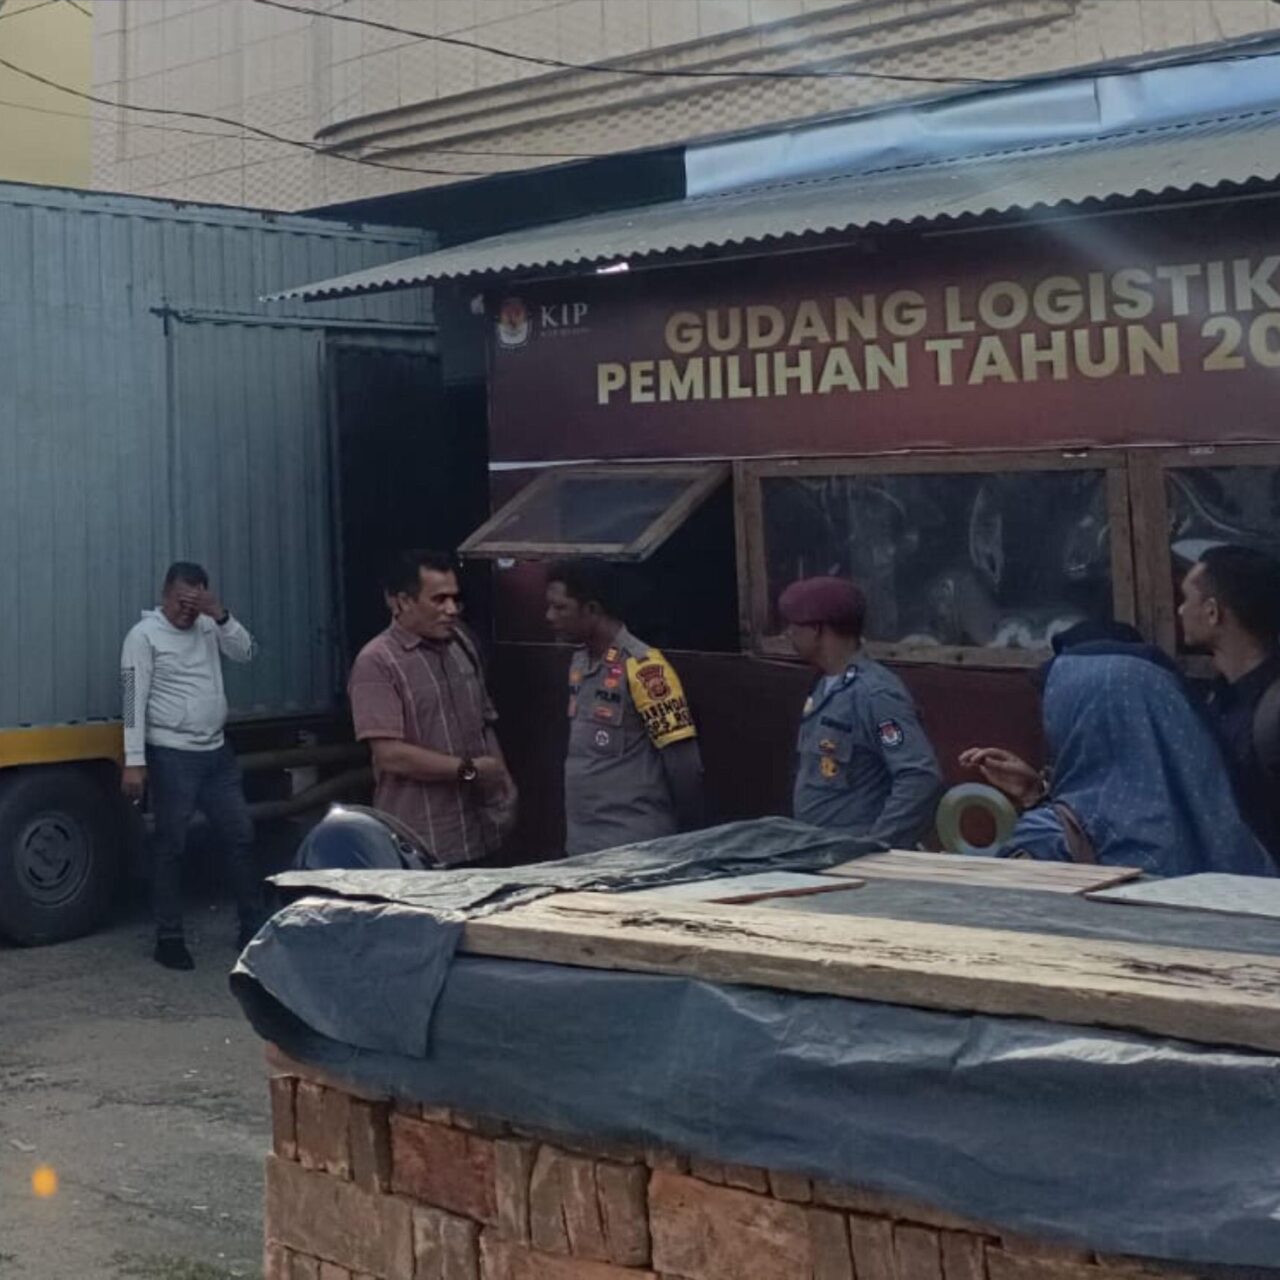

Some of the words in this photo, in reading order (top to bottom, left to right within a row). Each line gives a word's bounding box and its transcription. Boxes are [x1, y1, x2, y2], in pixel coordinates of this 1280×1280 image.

[541, 302, 588, 328] KIP
[665, 290, 927, 354] GUDANG
[945, 255, 1280, 333] LOGISTIK
[597, 341, 908, 405] PEMILIHAN
[925, 322, 1180, 386] TAHUN
